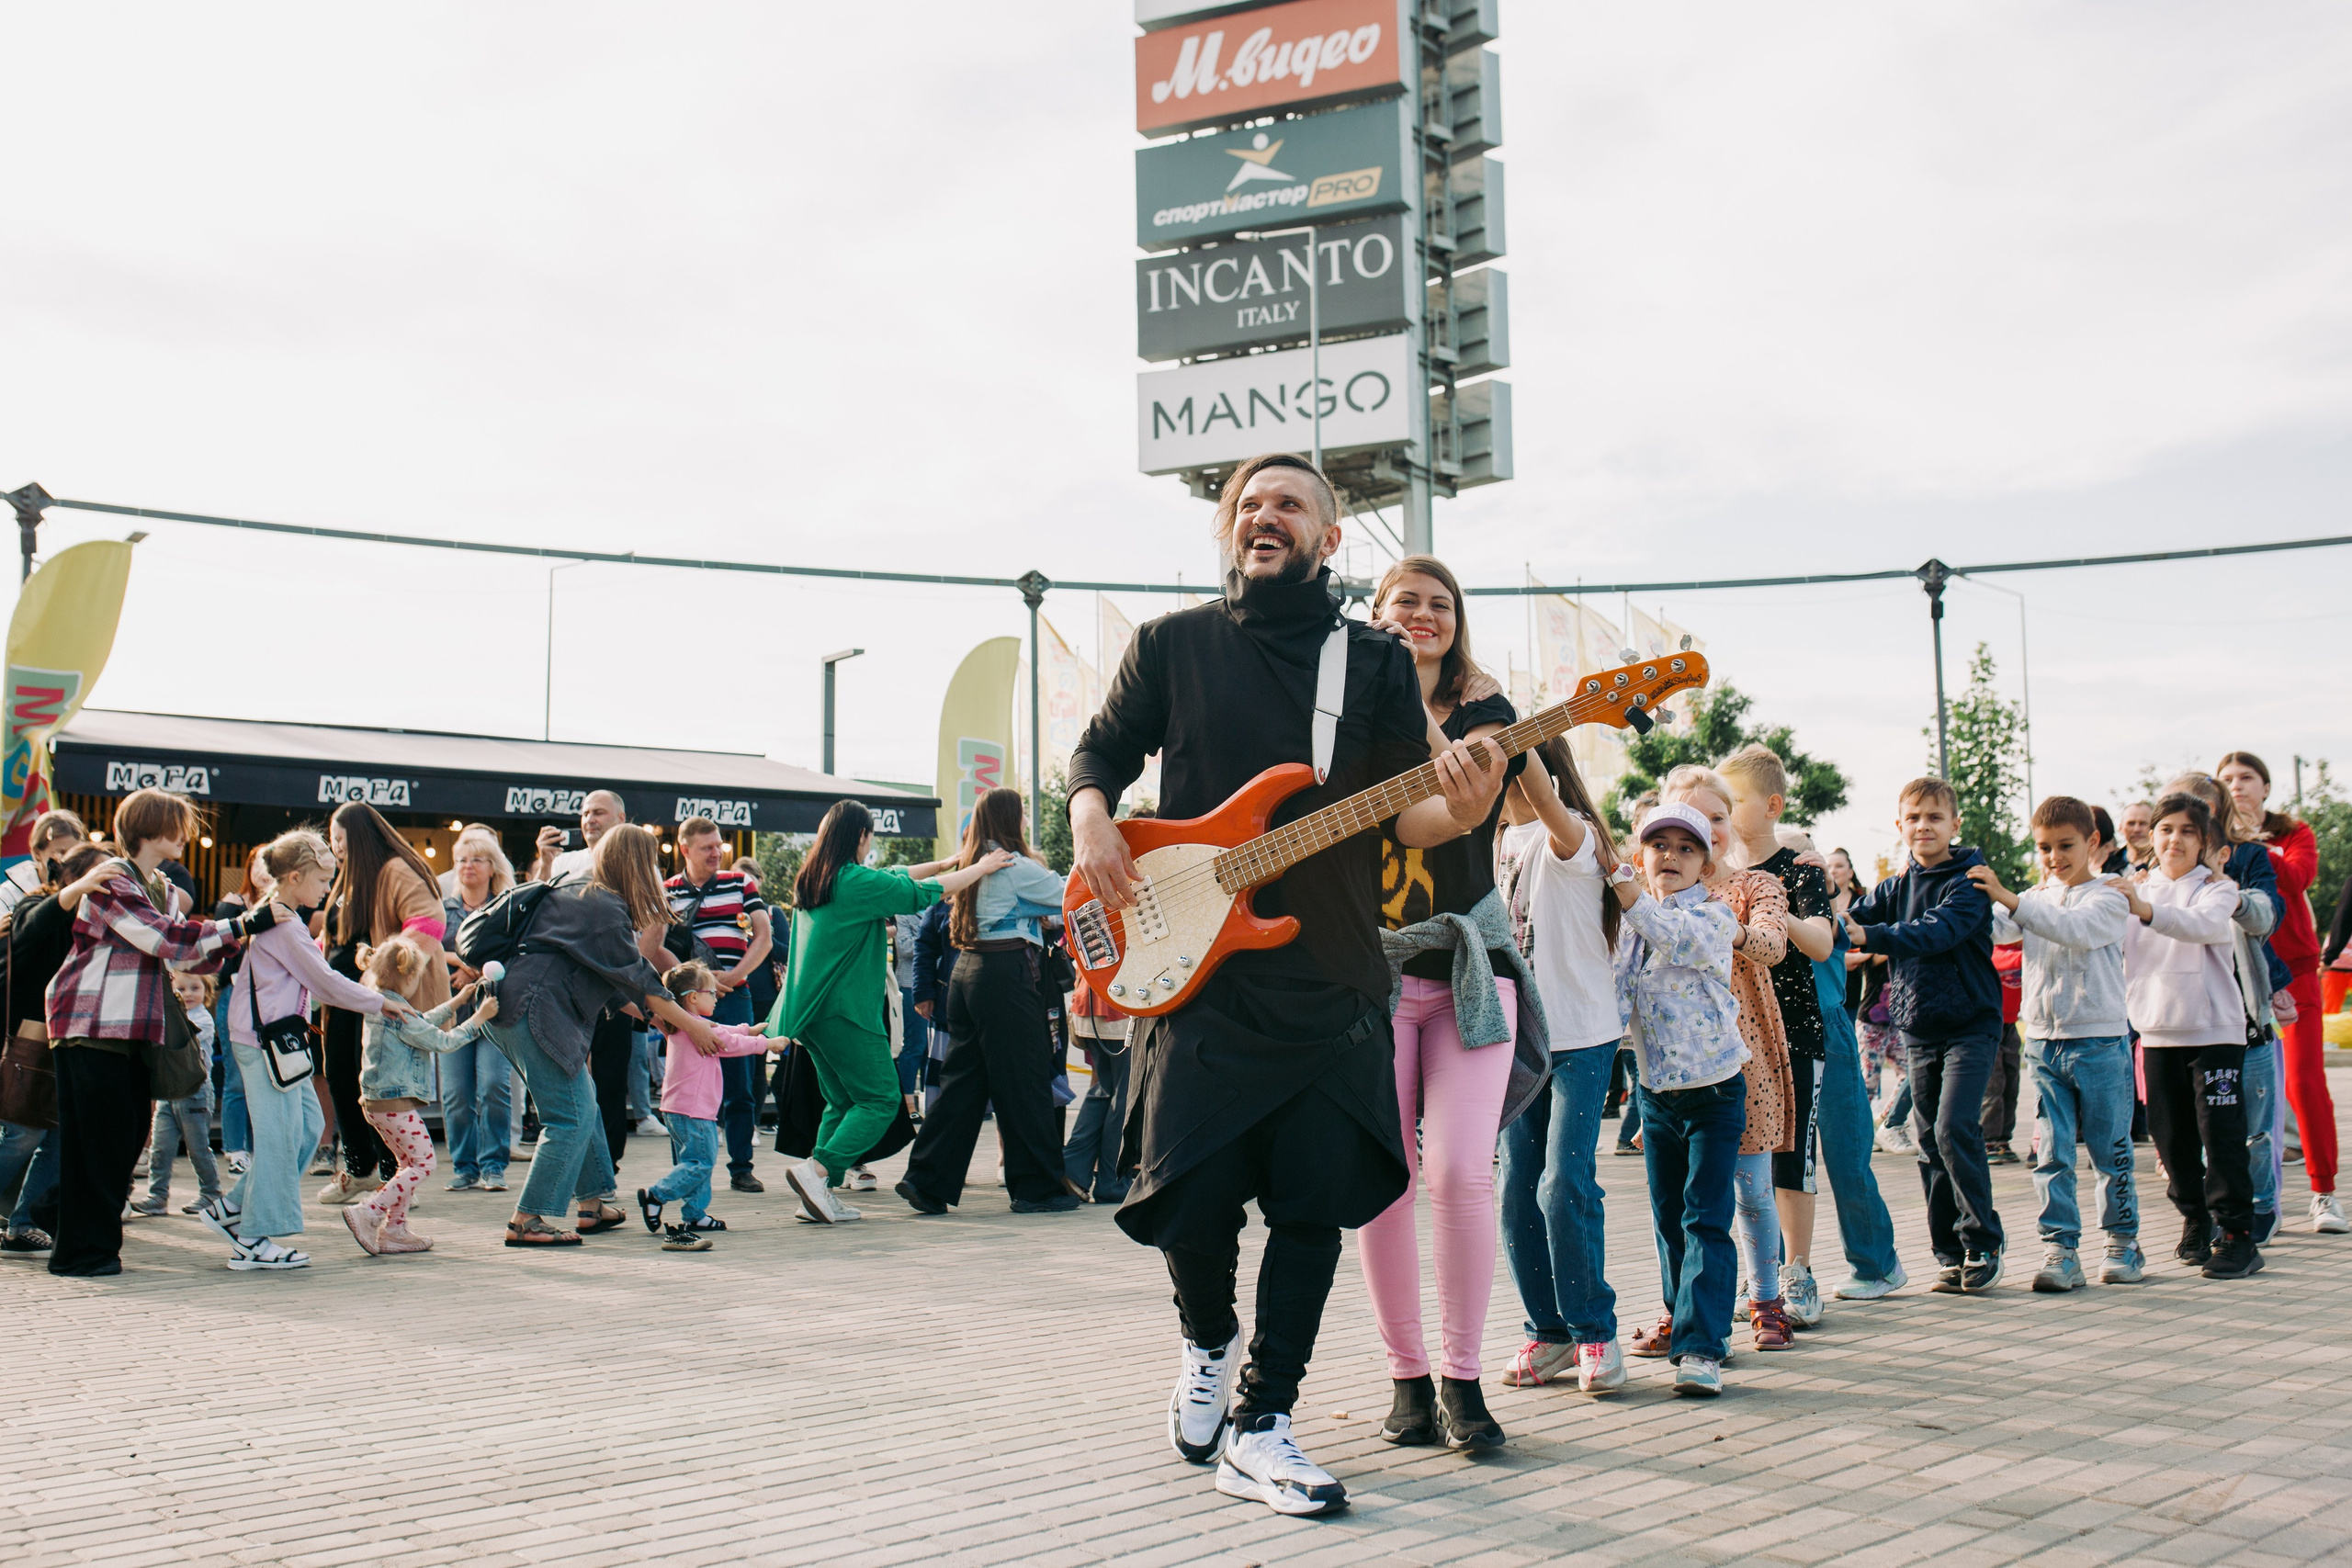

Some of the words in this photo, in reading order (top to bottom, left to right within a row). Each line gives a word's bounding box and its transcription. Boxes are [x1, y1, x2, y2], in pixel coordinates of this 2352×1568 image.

[1151, 23, 1381, 104] М.видео
[1314, 175, 1375, 200] PRO
[1147, 233, 1394, 312] INCANTO
[1237, 300, 1301, 329] ITALY
[1152, 370, 1391, 440] MANGO
[2204, 1068, 2239, 1085] LAST
[2206, 1094, 2238, 1106] TIME
